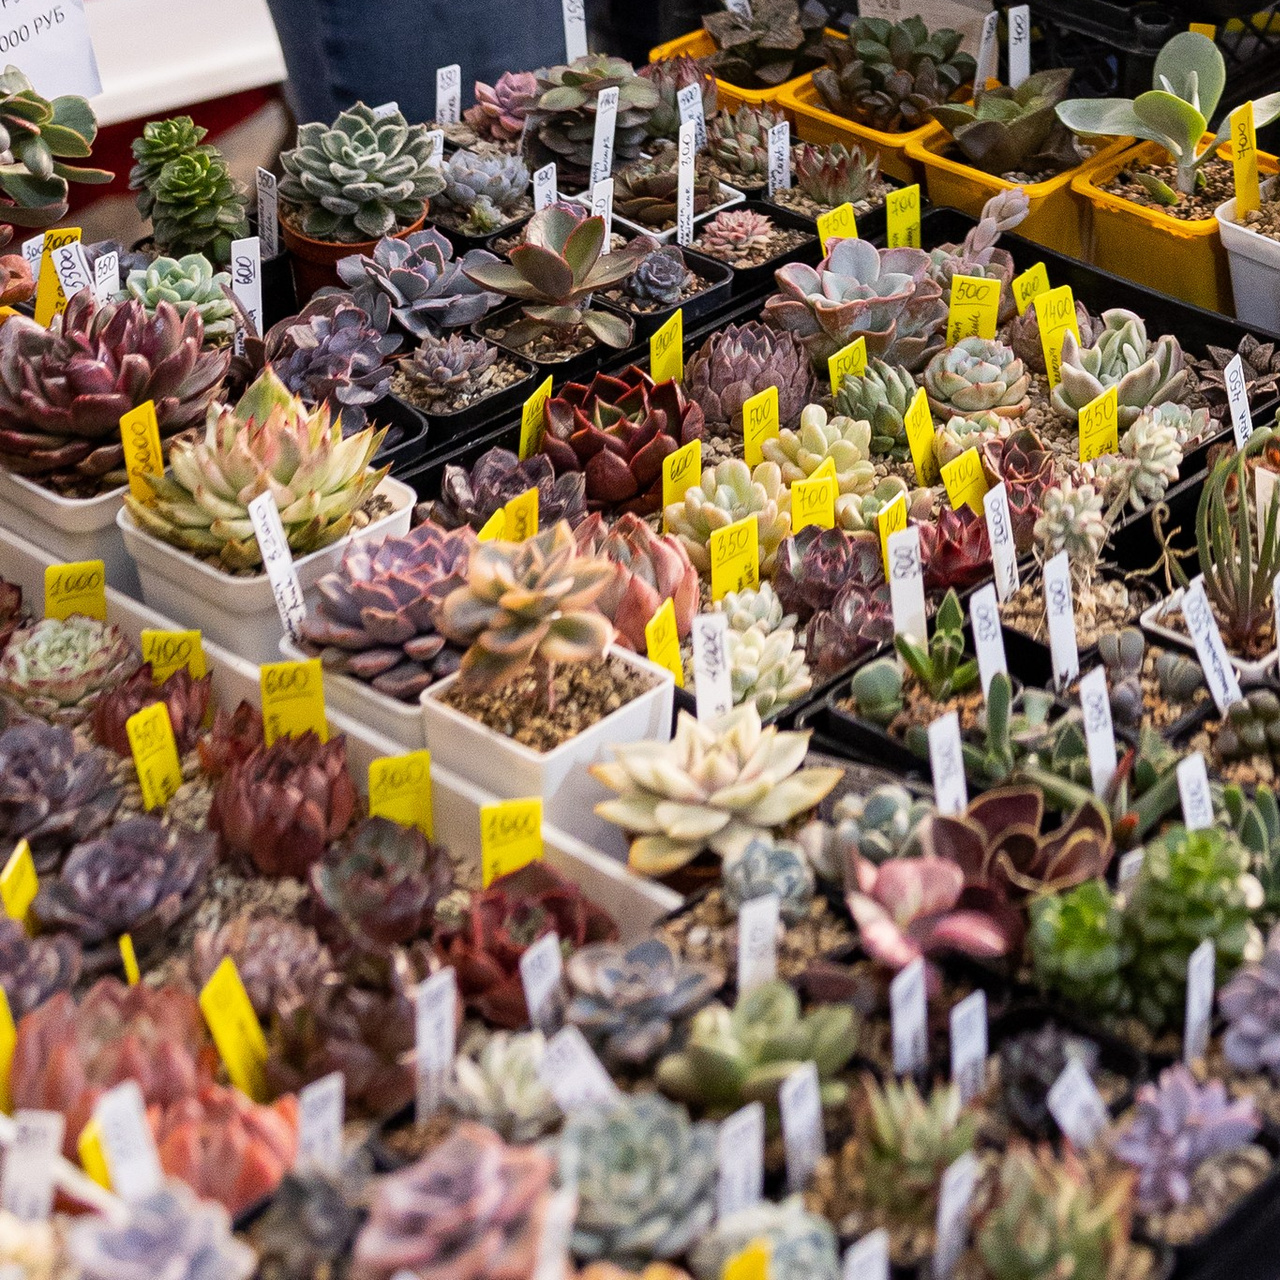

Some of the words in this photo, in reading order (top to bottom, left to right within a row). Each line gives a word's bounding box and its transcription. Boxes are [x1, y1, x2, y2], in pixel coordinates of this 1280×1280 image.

[33, 5, 65, 35] РУБ
[682, 133, 693, 167] 300
[1237, 122, 1251, 162] 700
[891, 191, 918, 216] 700
[822, 209, 849, 233] 750
[236, 255, 252, 285] 600
[954, 281, 990, 301] 500
[1042, 297, 1073, 326] 1400
[655, 322, 679, 358] 900
[836, 346, 862, 374] 500
[1227, 369, 1241, 404] 450
[749, 397, 772, 433] 500
[1083, 403, 1115, 437] 350
[669, 448, 695, 481] 600
[948, 457, 974, 488] 400
[797, 483, 829, 510] 700
[716, 525, 750, 561] 350
[52, 572, 100, 597] 1000
[148, 636, 193, 663] 400
[266, 666, 309, 693] 600
